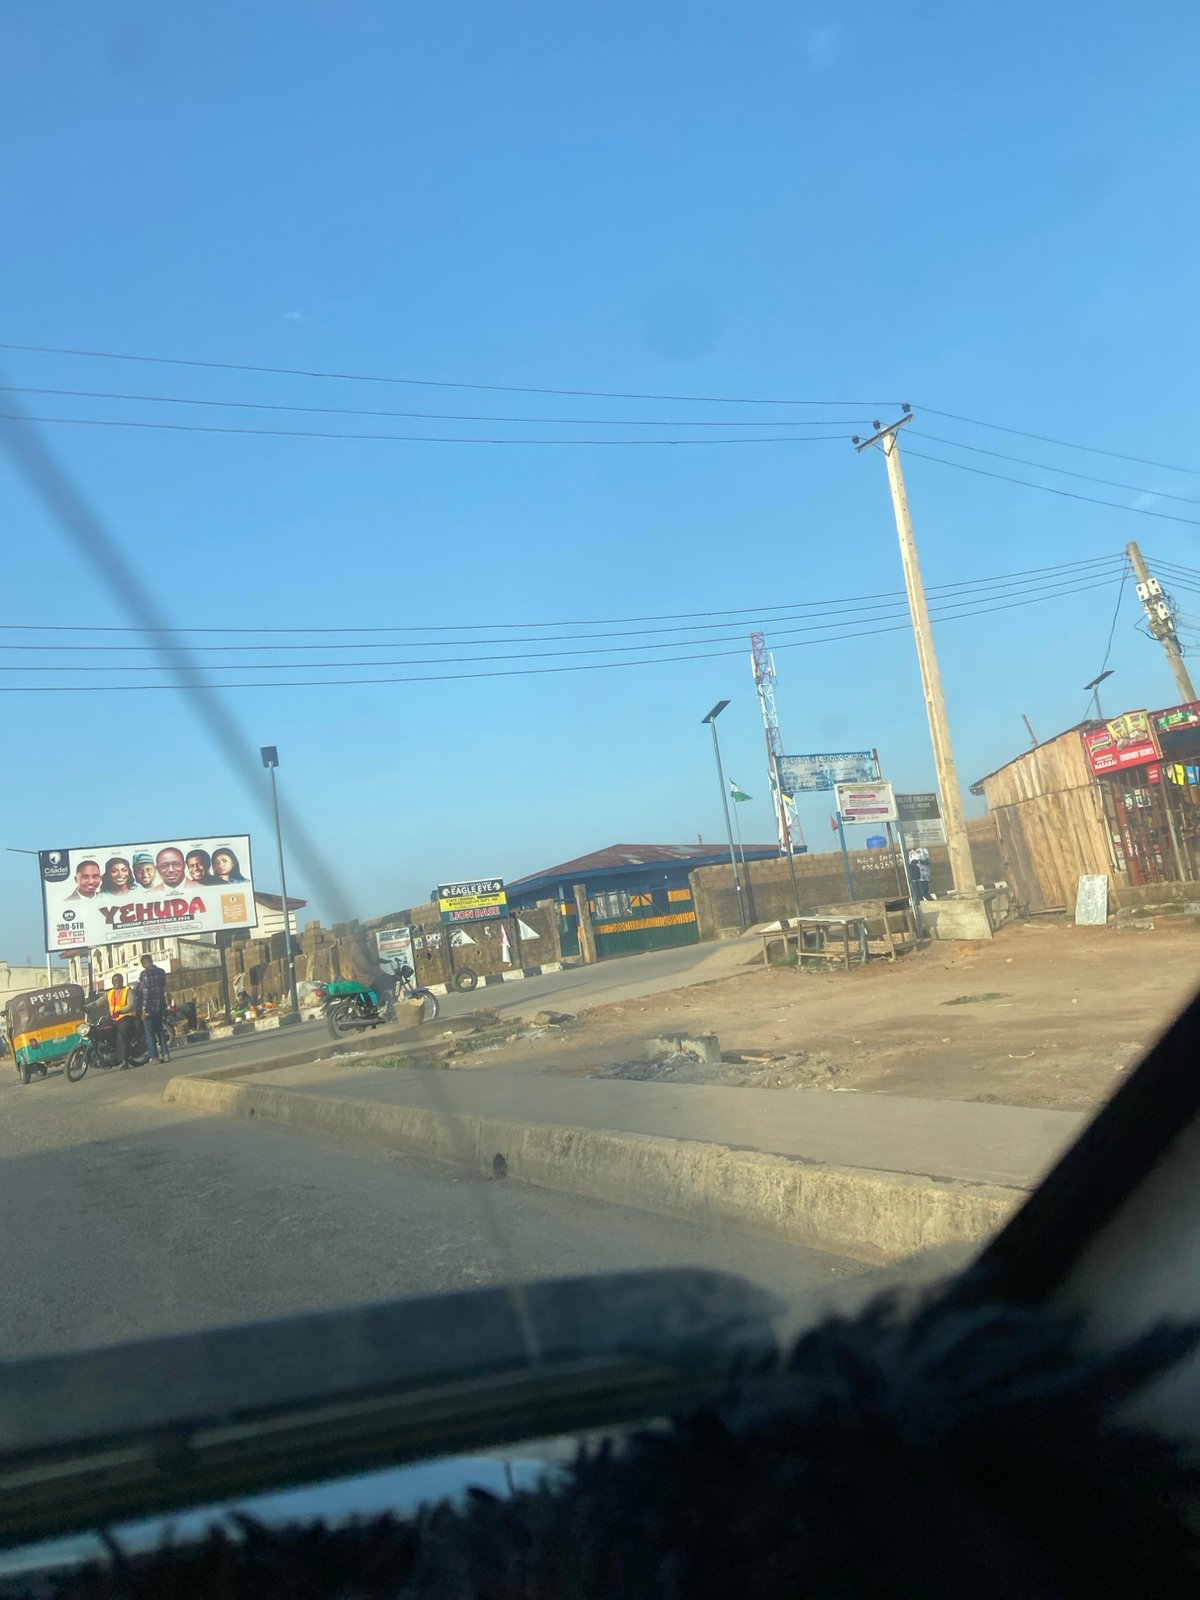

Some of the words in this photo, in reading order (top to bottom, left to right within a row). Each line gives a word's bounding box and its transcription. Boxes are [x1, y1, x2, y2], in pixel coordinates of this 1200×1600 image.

[451, 887, 476, 895] EAGLE
[477, 884, 492, 892] EYE
[99, 896, 206, 924] YEHUDA
[449, 909, 474, 921] LION
[474, 906, 500, 918] BASE
